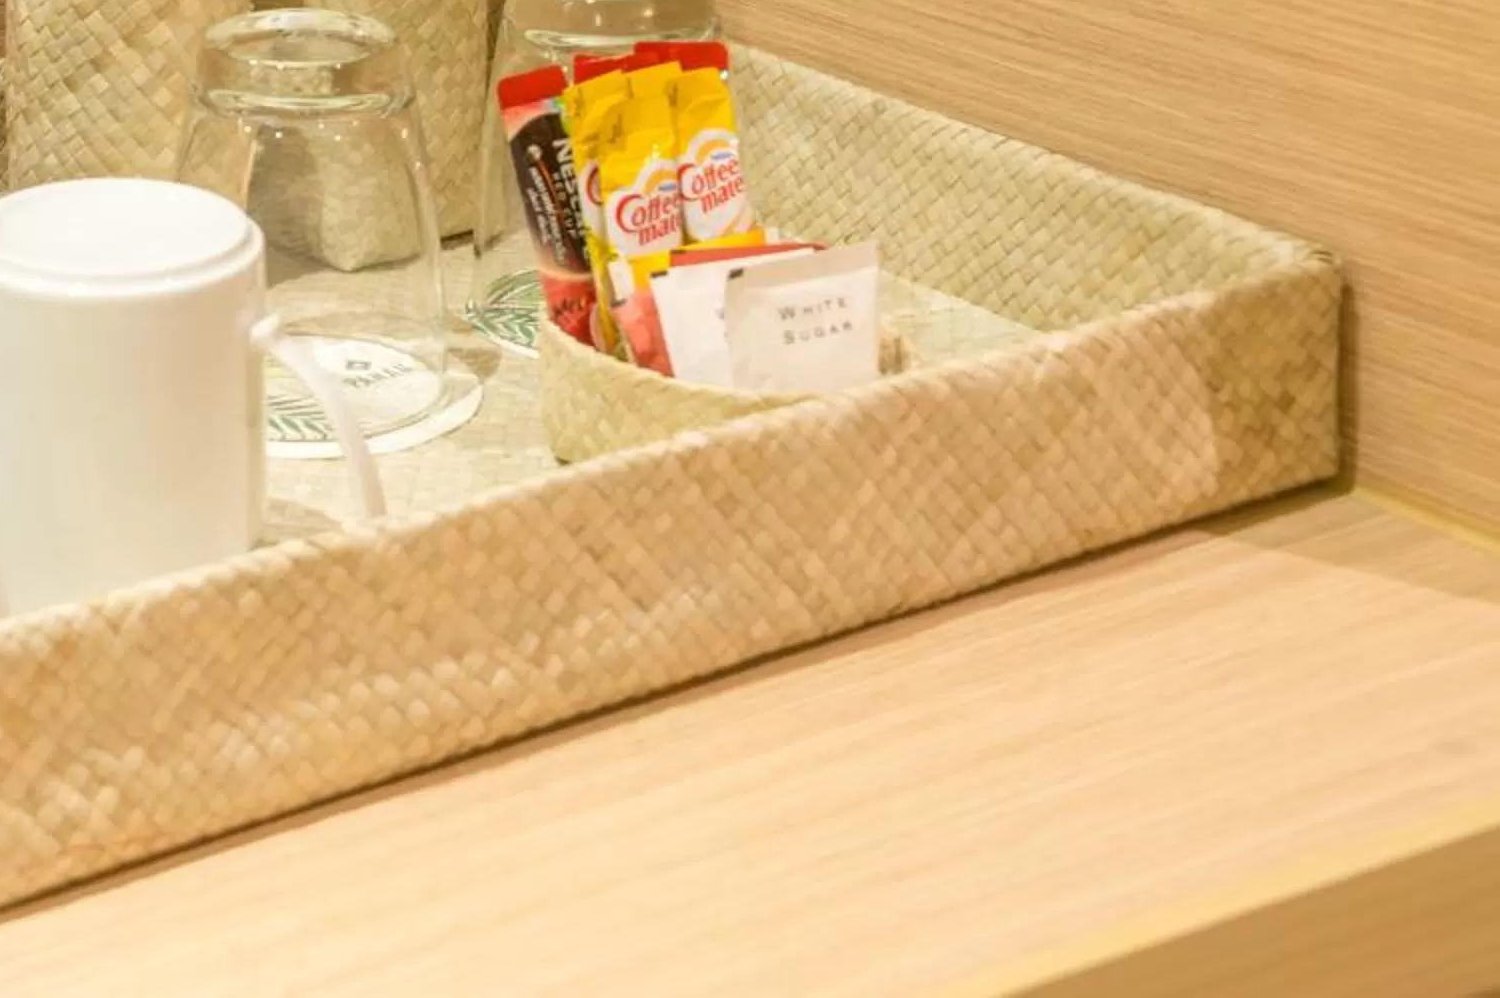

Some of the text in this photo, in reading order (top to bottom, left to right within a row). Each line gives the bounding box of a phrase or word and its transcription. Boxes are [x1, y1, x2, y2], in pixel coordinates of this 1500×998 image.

[677, 160, 739, 201] Coffee
[701, 176, 745, 214] mate
[638, 214, 680, 246] mat
